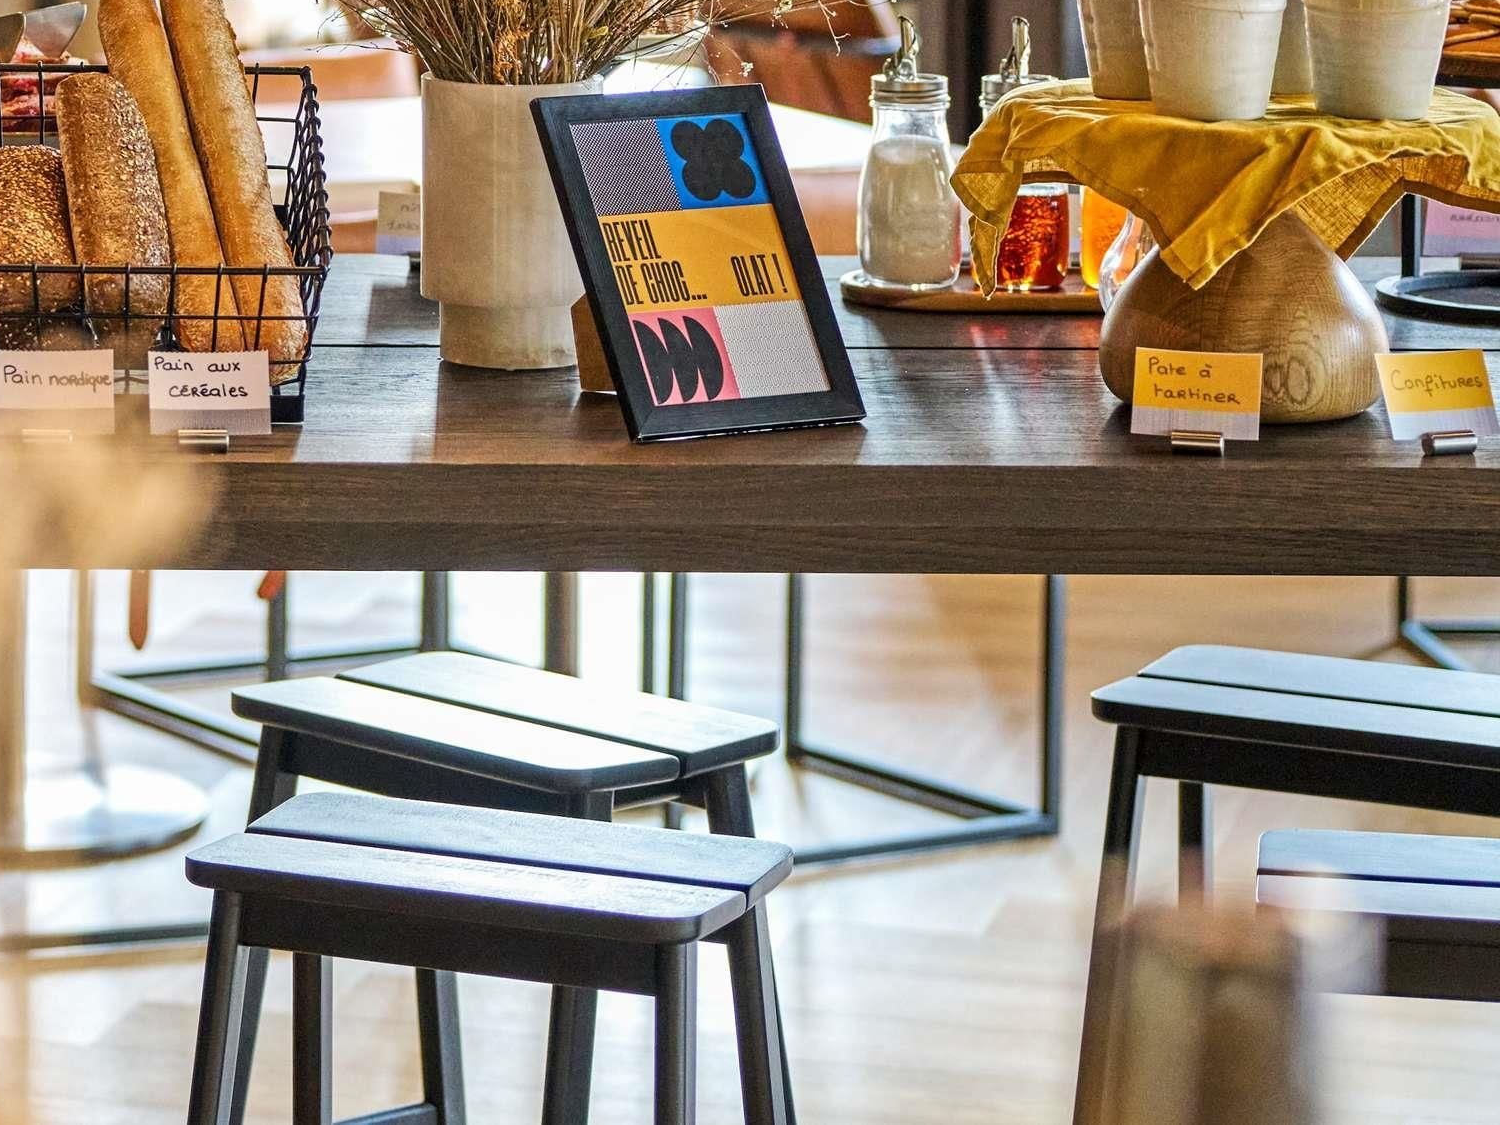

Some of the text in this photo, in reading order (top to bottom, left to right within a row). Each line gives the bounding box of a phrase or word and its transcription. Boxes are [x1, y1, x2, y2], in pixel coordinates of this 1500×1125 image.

[601, 219, 662, 263] REVEIL
[615, 264, 644, 306] DE
[730, 254, 775, 297] OLAT
[3, 364, 43, 385] Pain
[154, 356, 241, 373] Pain aux
[1198, 363, 1213, 379] à
